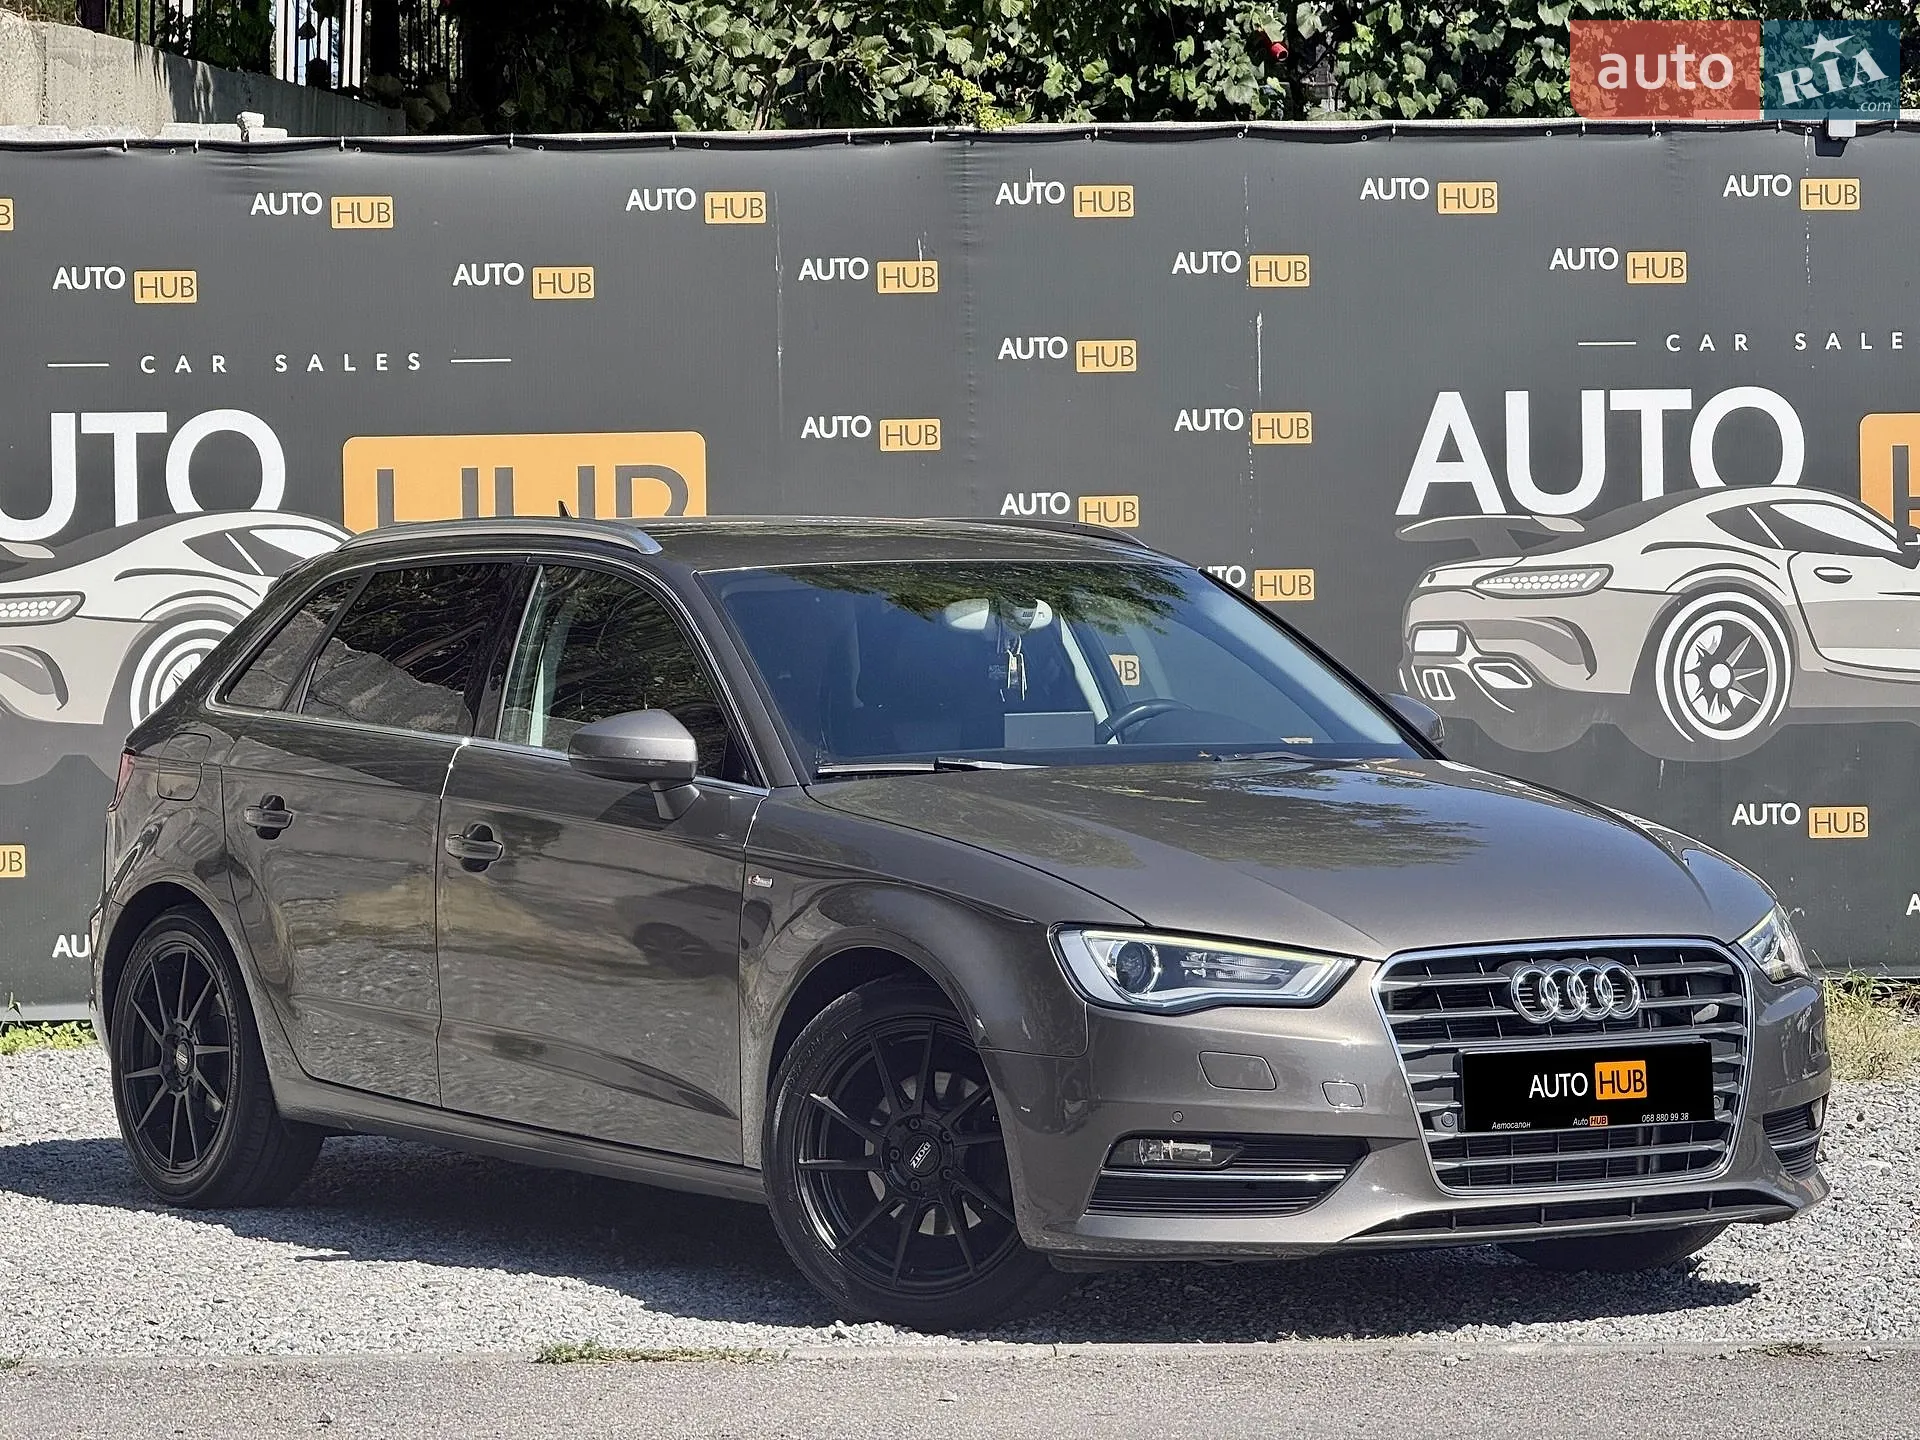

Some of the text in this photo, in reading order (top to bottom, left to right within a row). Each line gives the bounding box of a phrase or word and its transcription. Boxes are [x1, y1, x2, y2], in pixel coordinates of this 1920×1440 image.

[626, 188, 763, 218] AUTO HUB
[996, 182, 1131, 212] AUTO HUB
[1360, 178, 1495, 208] AUTO HUB
[1723, 174, 1858, 205] AUTO HUB
[251, 192, 390, 223] AUTO HUB
[798, 258, 935, 288] AUTO HUB
[1172, 251, 1306, 281] AUTO HUB
[1550, 248, 1684, 278] AUTO HUB
[53, 267, 194, 298] AUTO HUB
[453, 263, 591, 294] AUTO HUB
[998, 337, 1133, 367] AUTO HUB
[1667, 332, 1903, 351] CAR SALE
[141, 353, 421, 373] CAR SALES
[801, 416, 938, 446] AUTO HUB
[1174, 408, 1308, 439] AUTO HUB
[1395, 386, 1805, 516] AUTO
[0, 409, 286, 541] UTO
[1000, 492, 1136, 522] AUTO HUB
[1208, 566, 1311, 596] TO HUB
[1732, 803, 1866, 833] AUTO HUB
[52, 934, 89, 958] AU
[1529, 1069, 1645, 1098] AUTO HUB
[1572, 1116, 1607, 1126] Auto HUB
[1656, 1113, 1669, 1122] 880
[1670, 1112, 1679, 1121] 99
